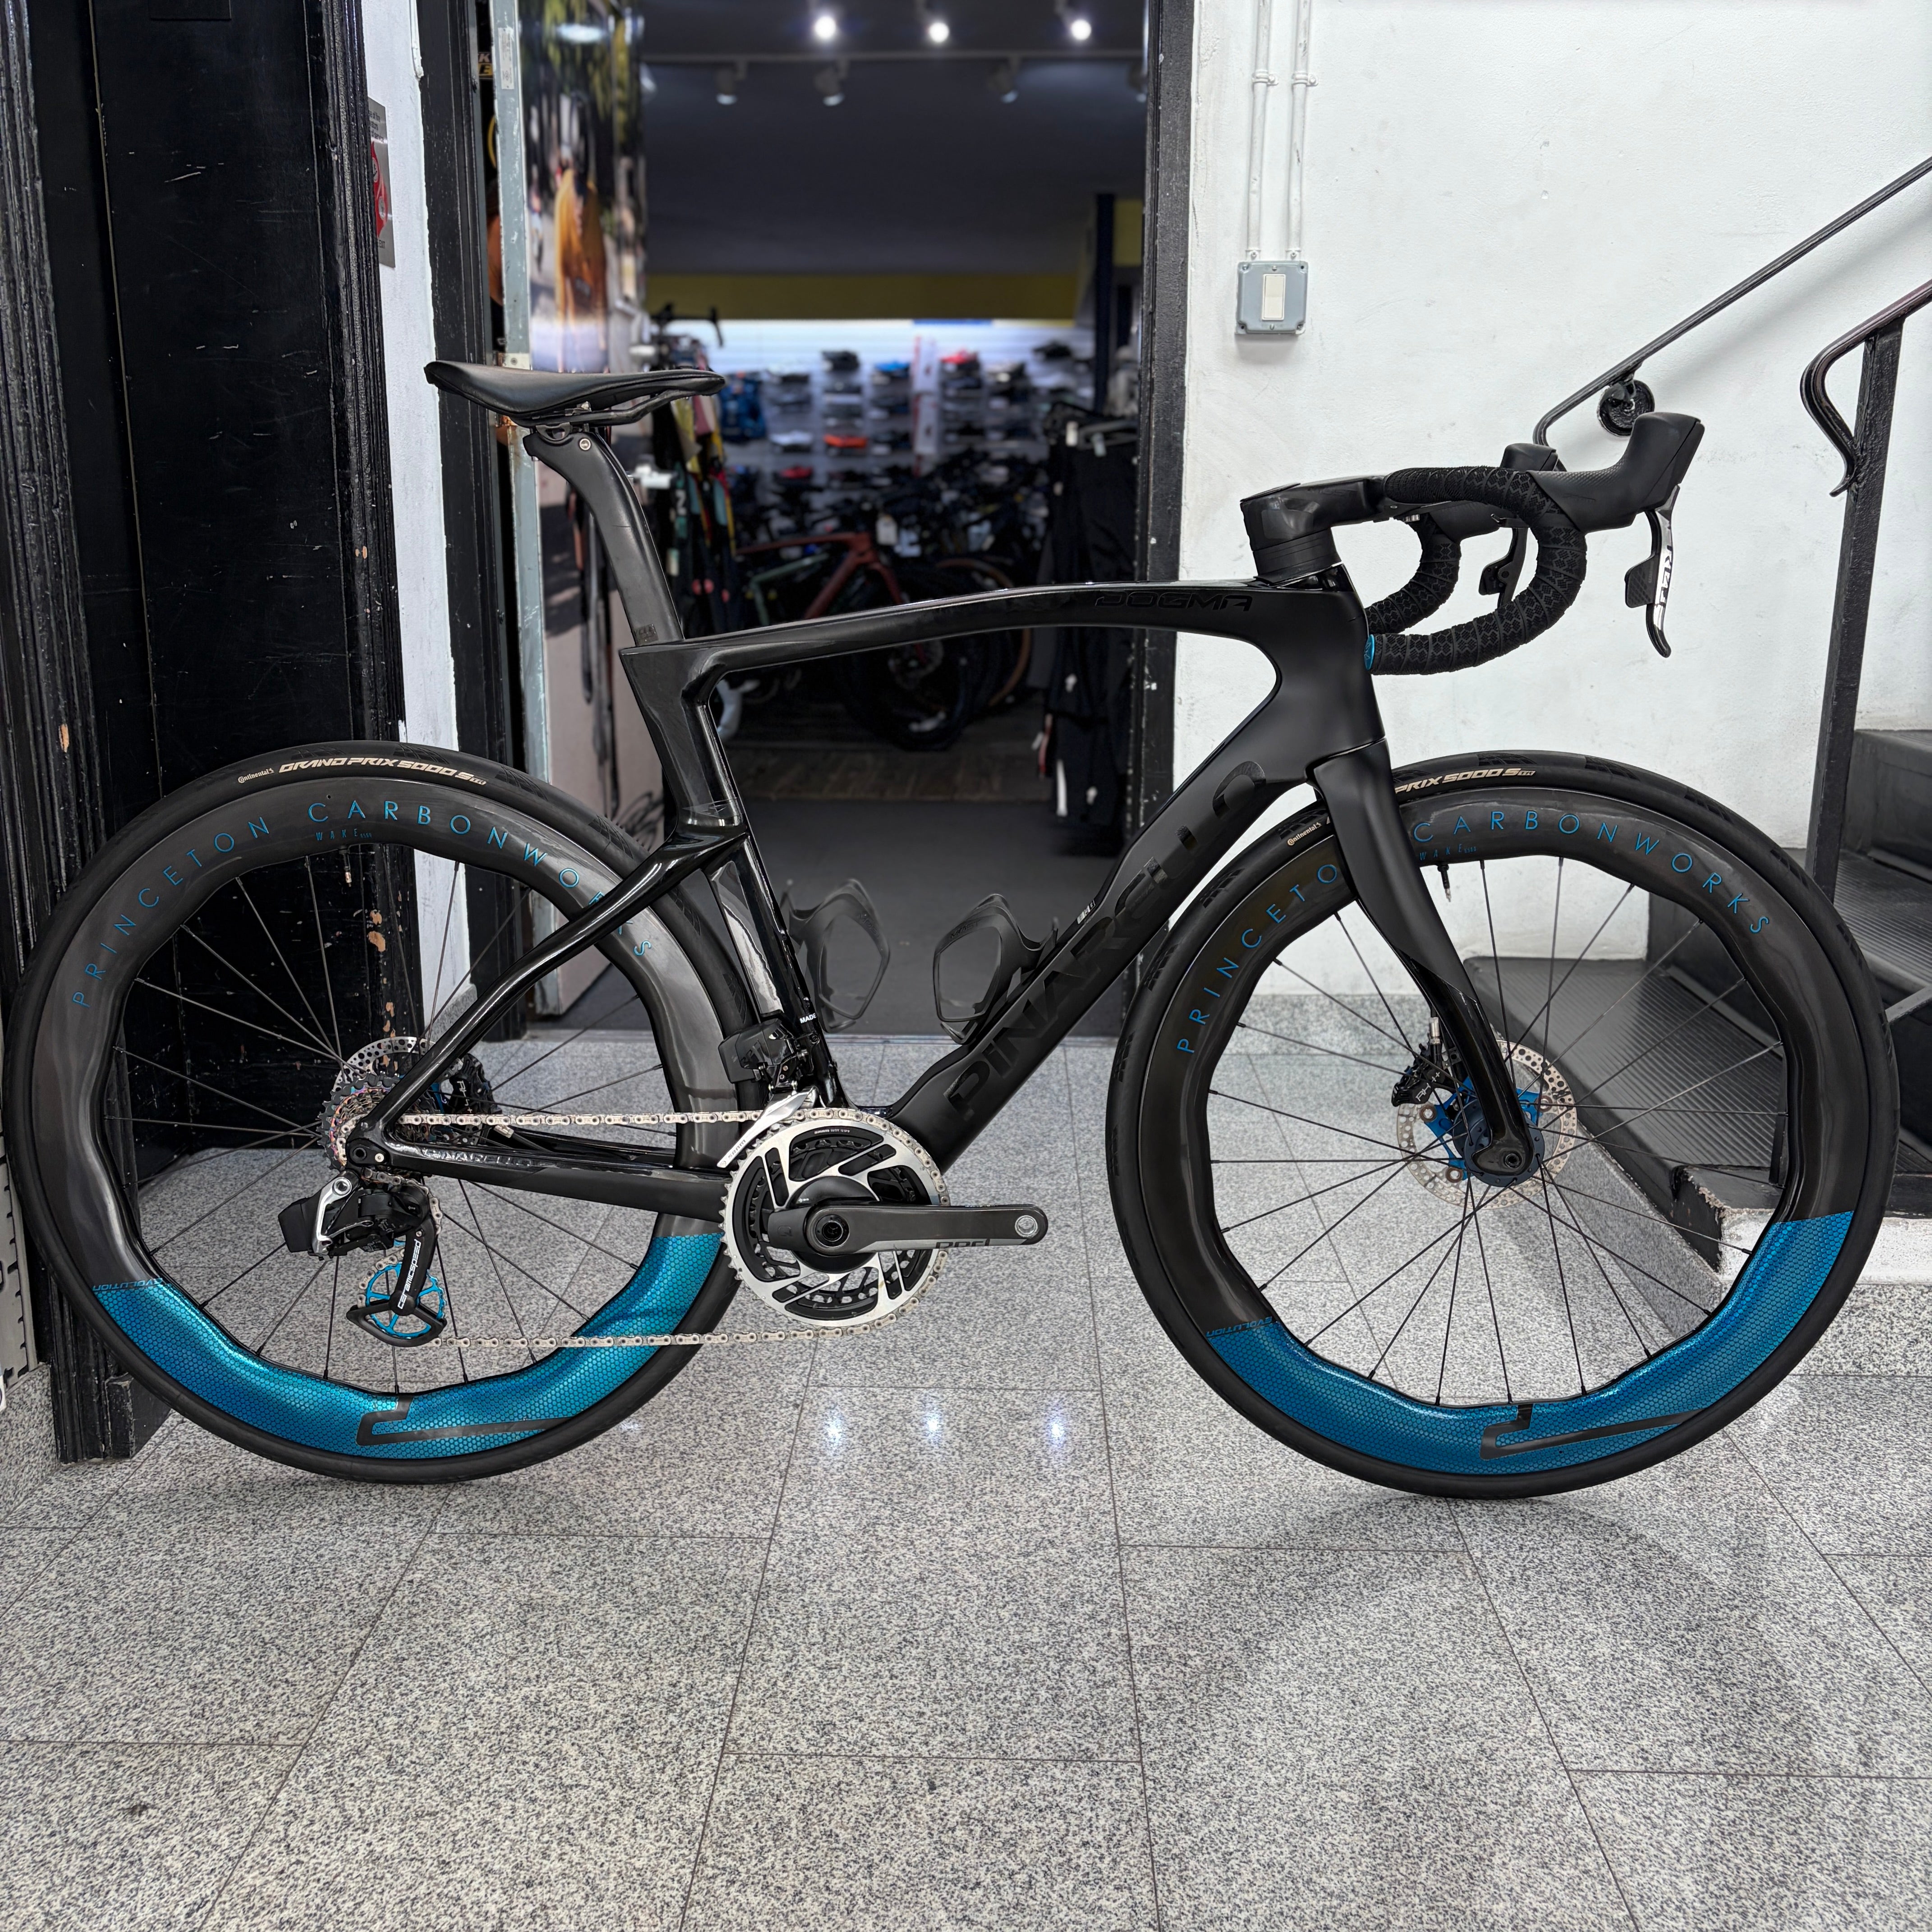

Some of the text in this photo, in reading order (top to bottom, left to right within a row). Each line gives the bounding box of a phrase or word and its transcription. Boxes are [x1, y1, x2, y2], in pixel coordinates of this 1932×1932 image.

[1095, 591, 1253, 612] DOGMA
[238, 768, 272, 783] Continental
[279, 758, 348, 773] GRAND
[347, 758, 399, 767] PRIX
[397, 760, 457, 776] 5000
[1394, 776, 1442, 794] PRIX
[1442, 768, 1504, 783] 5000
[316, 828, 358, 841] WAKE
[1287, 823, 1321, 846] Continental
[1419, 844, 1463, 861] WAKE
[72, 800, 651, 1007] PRINCETON CARBONWOS
[1177, 810, 1770, 1054] PRINCETO CARBONWORKS
[799, 1012, 817, 1024] MADE
